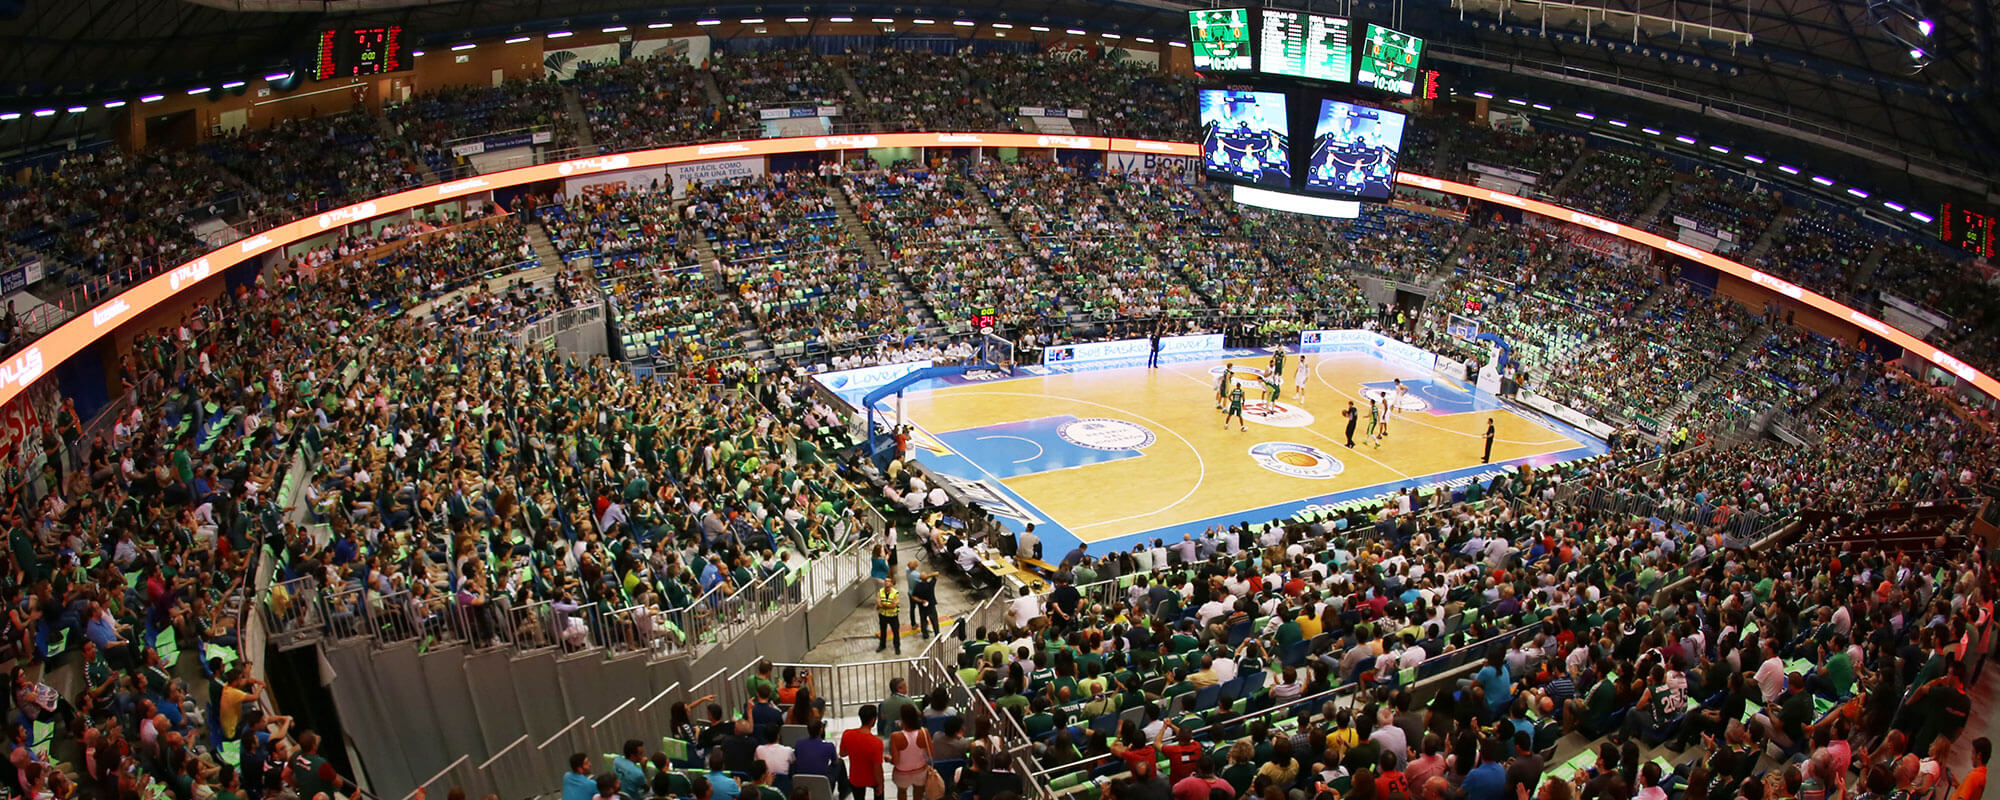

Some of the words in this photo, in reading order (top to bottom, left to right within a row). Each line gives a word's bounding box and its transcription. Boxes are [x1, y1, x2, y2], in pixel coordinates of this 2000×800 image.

[1209, 56, 1238, 71] 10:00
[1373, 74, 1401, 93] 10:00
[680, 171, 709, 180] PULSAR
[729, 168, 752, 176] TECLA
[980, 315, 994, 328] 24
[1168, 339, 1199, 350] Lover
[852, 369, 898, 386] Lover
